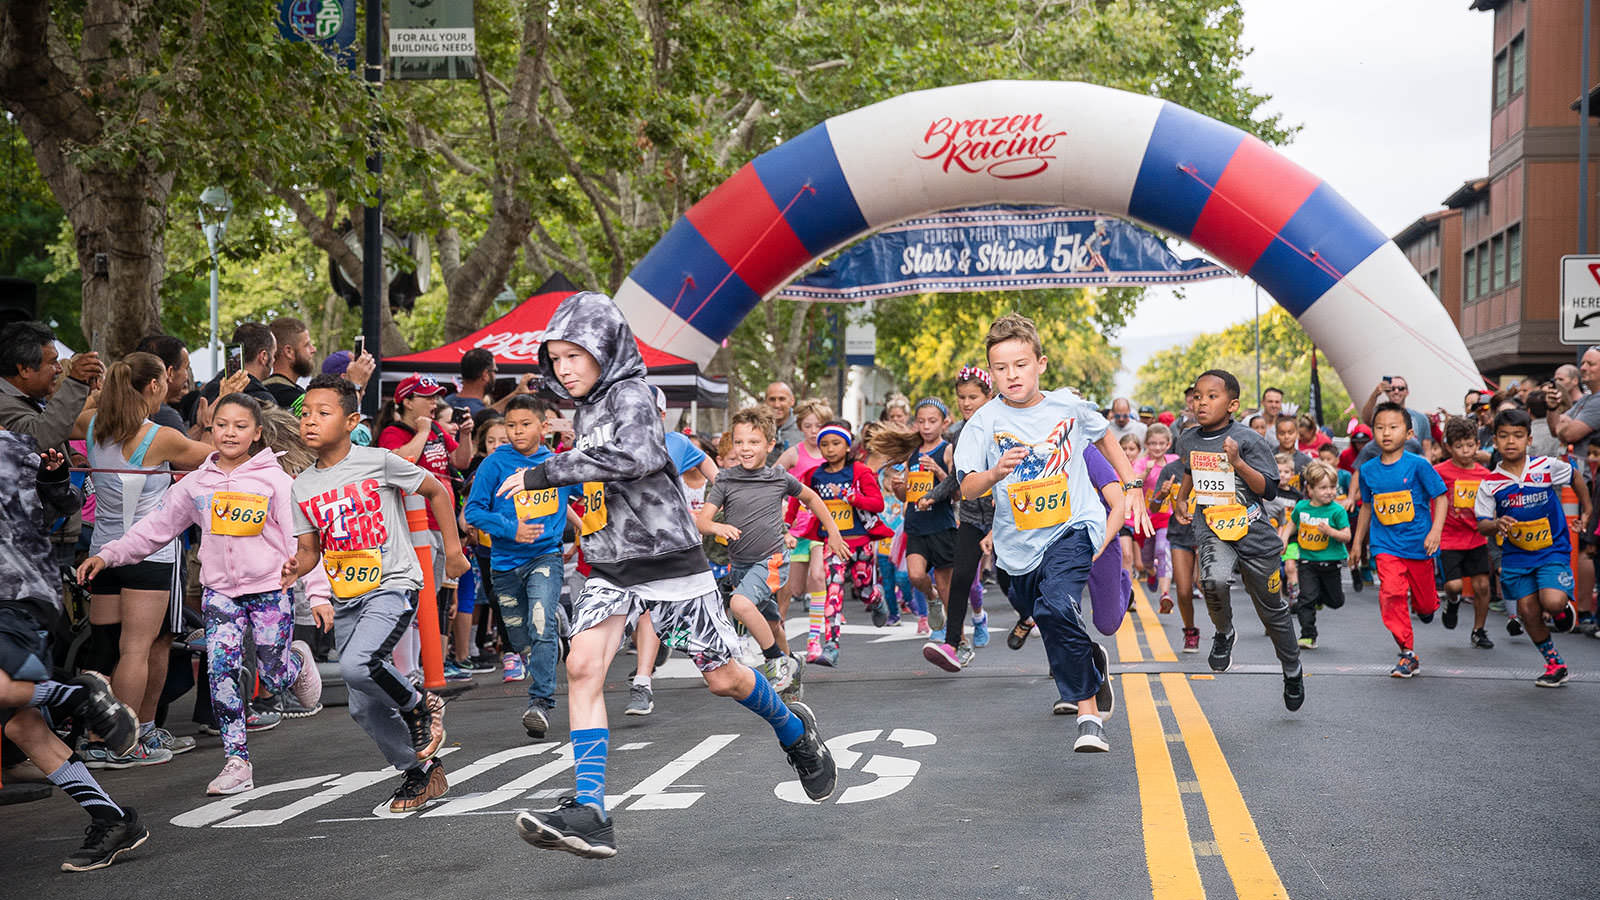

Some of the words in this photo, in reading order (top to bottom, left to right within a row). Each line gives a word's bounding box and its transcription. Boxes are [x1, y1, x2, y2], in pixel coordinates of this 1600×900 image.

[397, 33, 417, 42] FOR
[419, 33, 437, 42] ALL
[439, 32, 467, 42] YOUR
[391, 43, 440, 53] BUILDING
[442, 43, 473, 52] NEEDS
[912, 113, 1046, 160] Brazen
[942, 131, 1067, 180] Racing
[900, 242, 956, 276] Stars
[959, 246, 972, 276] &
[975, 239, 1048, 276] Stripes
[1572, 296, 1600, 309] HERE
[912, 482, 932, 492] 890
[1197, 479, 1225, 491] 1935
[533, 488, 557, 505] 964
[1034, 490, 1067, 513] 951
[1388, 502, 1412, 514] 897
[230, 507, 266, 524] 963
[1215, 516, 1247, 530] 844
[1307, 533, 1329, 543] 908
[1525, 529, 1549, 542] 917
[344, 565, 380, 583] 950
